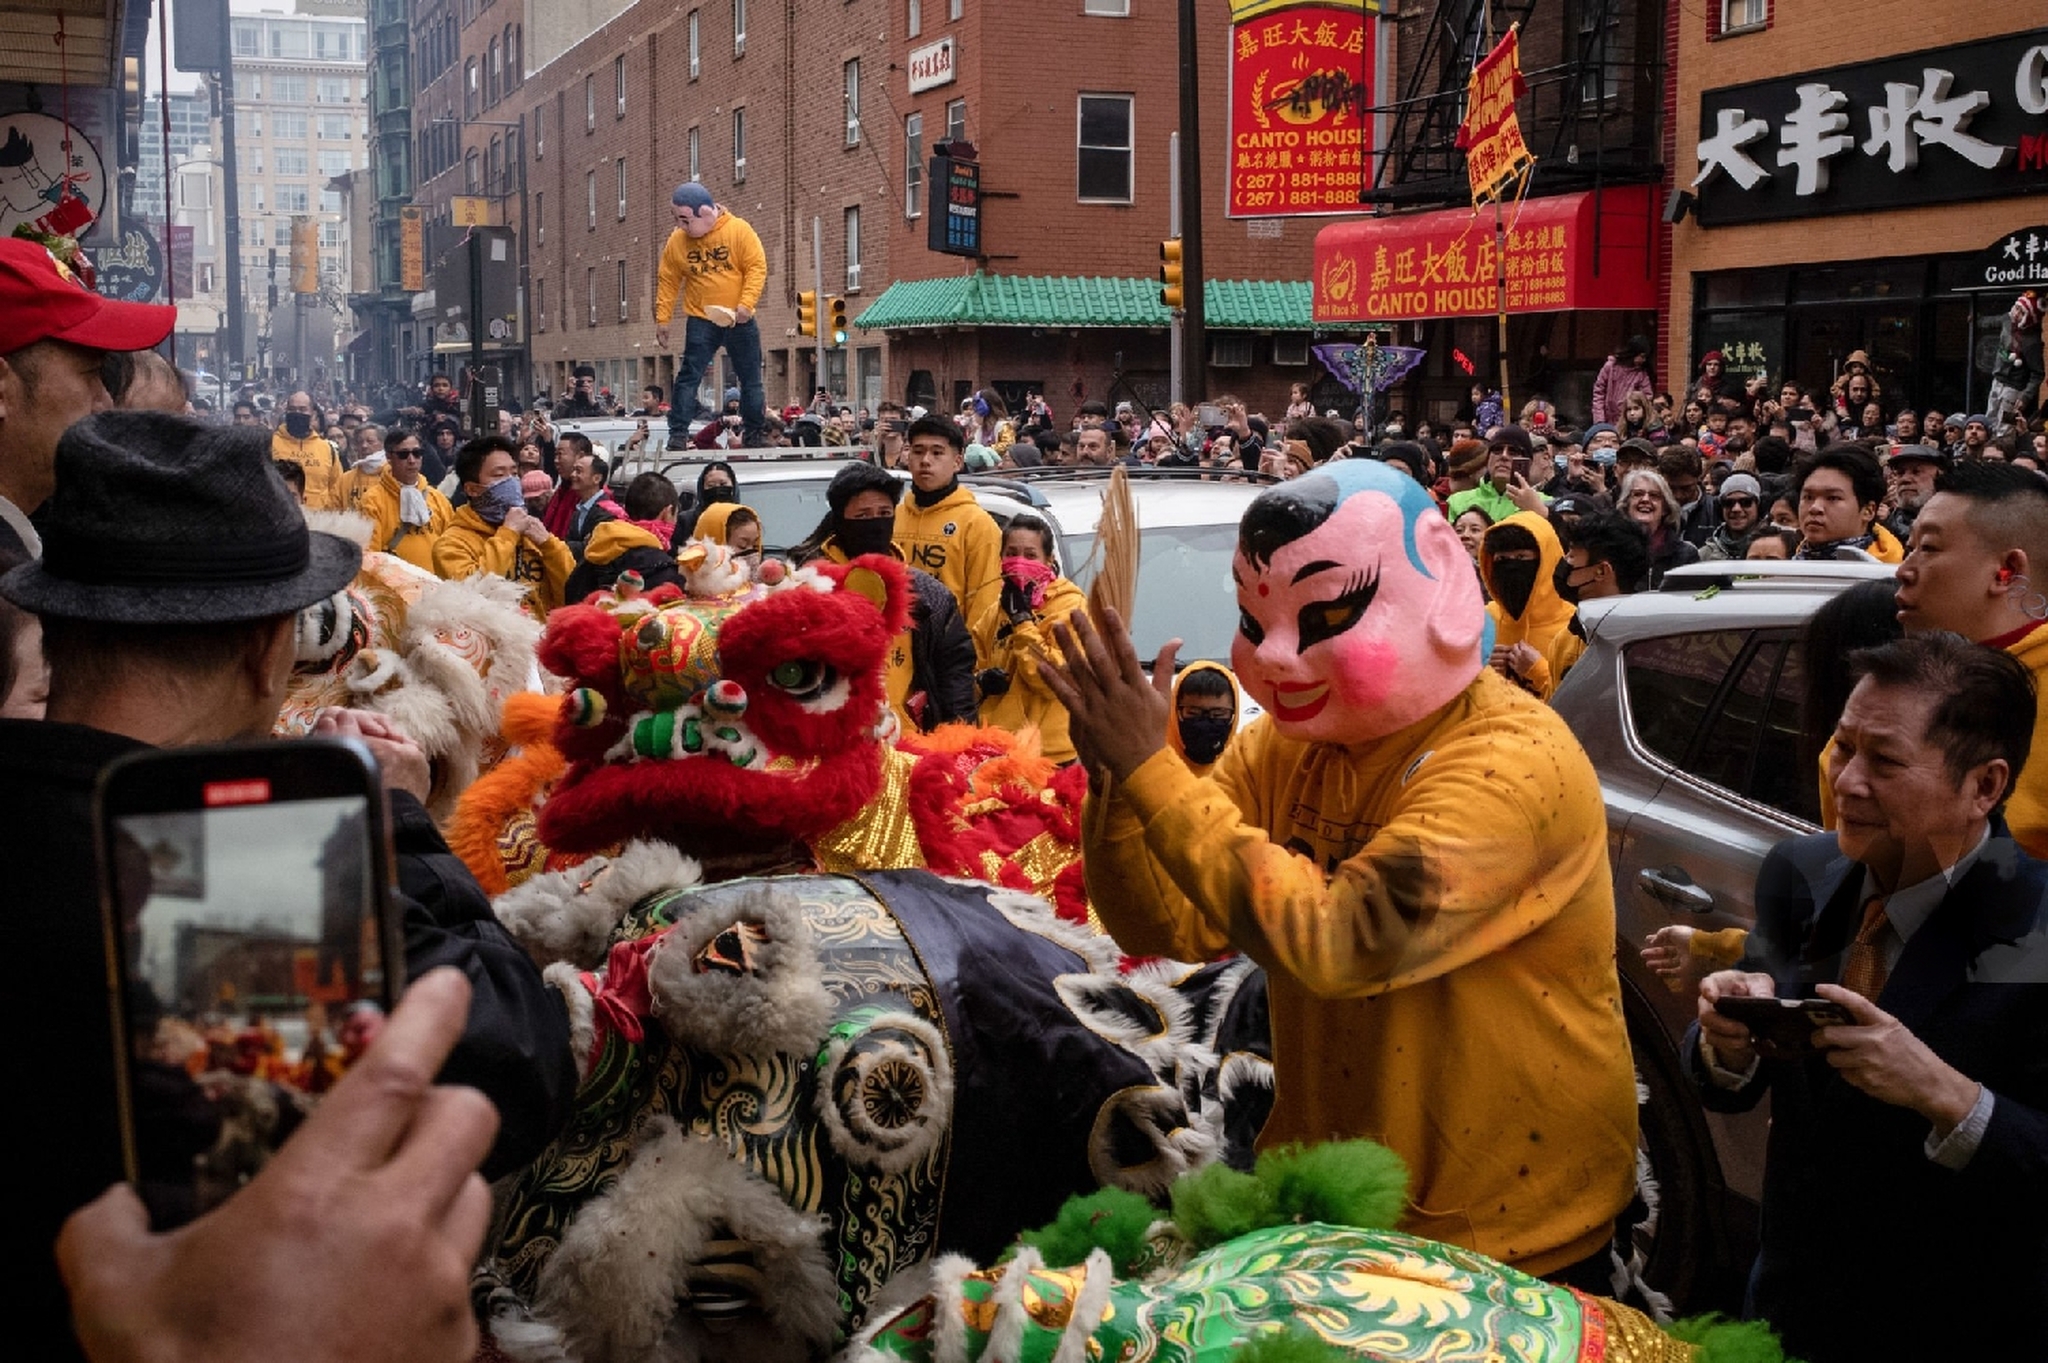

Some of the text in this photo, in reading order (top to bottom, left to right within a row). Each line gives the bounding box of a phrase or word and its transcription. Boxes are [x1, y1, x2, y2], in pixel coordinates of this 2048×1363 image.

[1237, 19, 1364, 61] 嘉旺大飯店
[1237, 128, 1367, 148] CANTO HOUSE
[2018, 133, 2048, 171] M
[1290, 189, 1361, 205] 881-888
[687, 245, 729, 263] SUNS
[2002, 233, 2048, 261] 大丰
[1370, 234, 1496, 291] 嘉旺大飯店
[1985, 261, 2024, 283] Good
[1367, 286, 1497, 315] CANTO HOUSE
